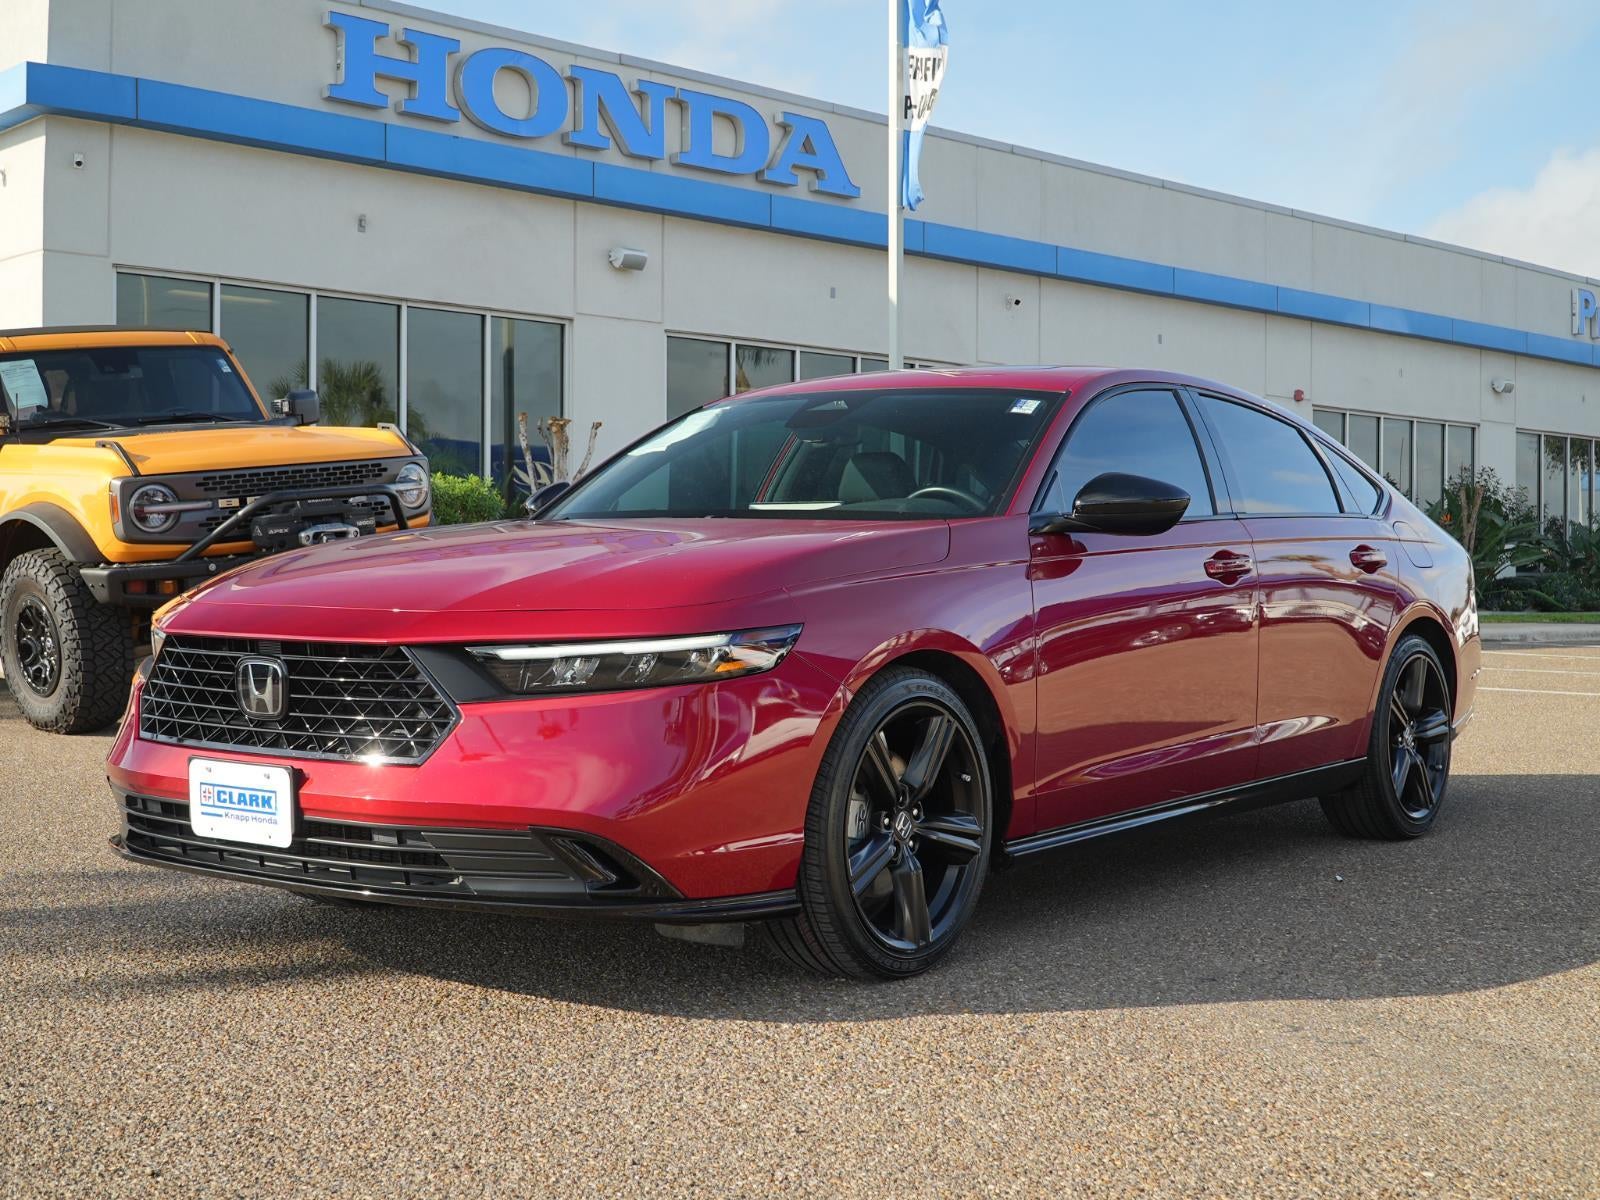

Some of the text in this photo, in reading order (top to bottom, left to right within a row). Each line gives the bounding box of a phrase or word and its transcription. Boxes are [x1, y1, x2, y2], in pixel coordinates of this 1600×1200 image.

[324, 11, 860, 199] HONDA
[1573, 288, 1600, 338] P
[217, 790, 273, 809] CLARK
[225, 811, 278, 825] Knapp Honda
